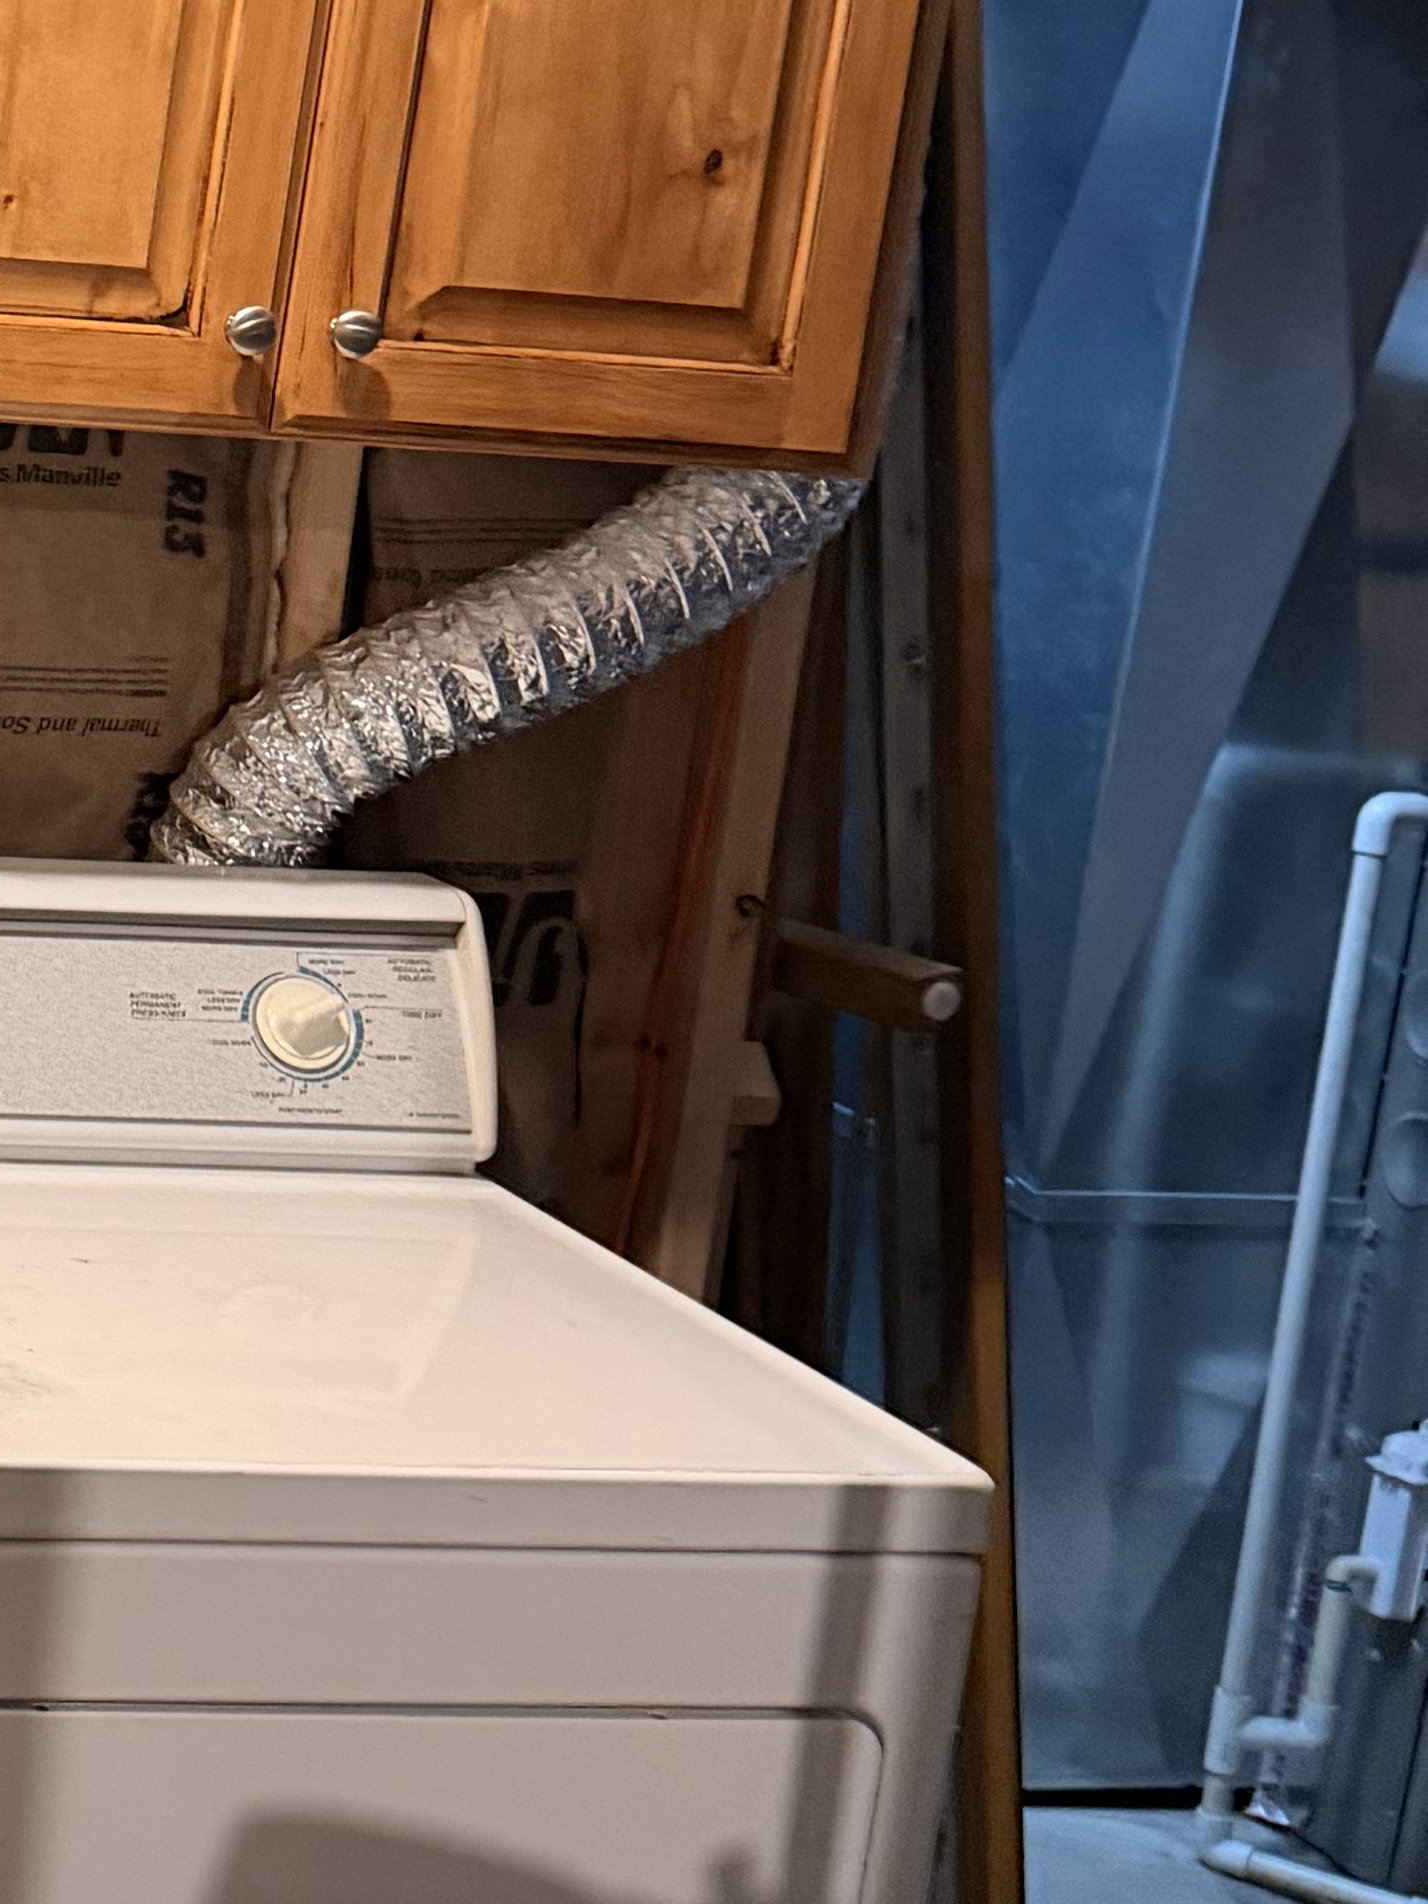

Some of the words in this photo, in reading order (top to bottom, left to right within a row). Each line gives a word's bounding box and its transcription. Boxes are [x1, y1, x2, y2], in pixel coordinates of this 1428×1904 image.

[15, 463, 123, 488] Manville
[163, 468, 209, 559] R13
[36, 715, 78, 735] and
[82, 716, 162, 738] Thermal
